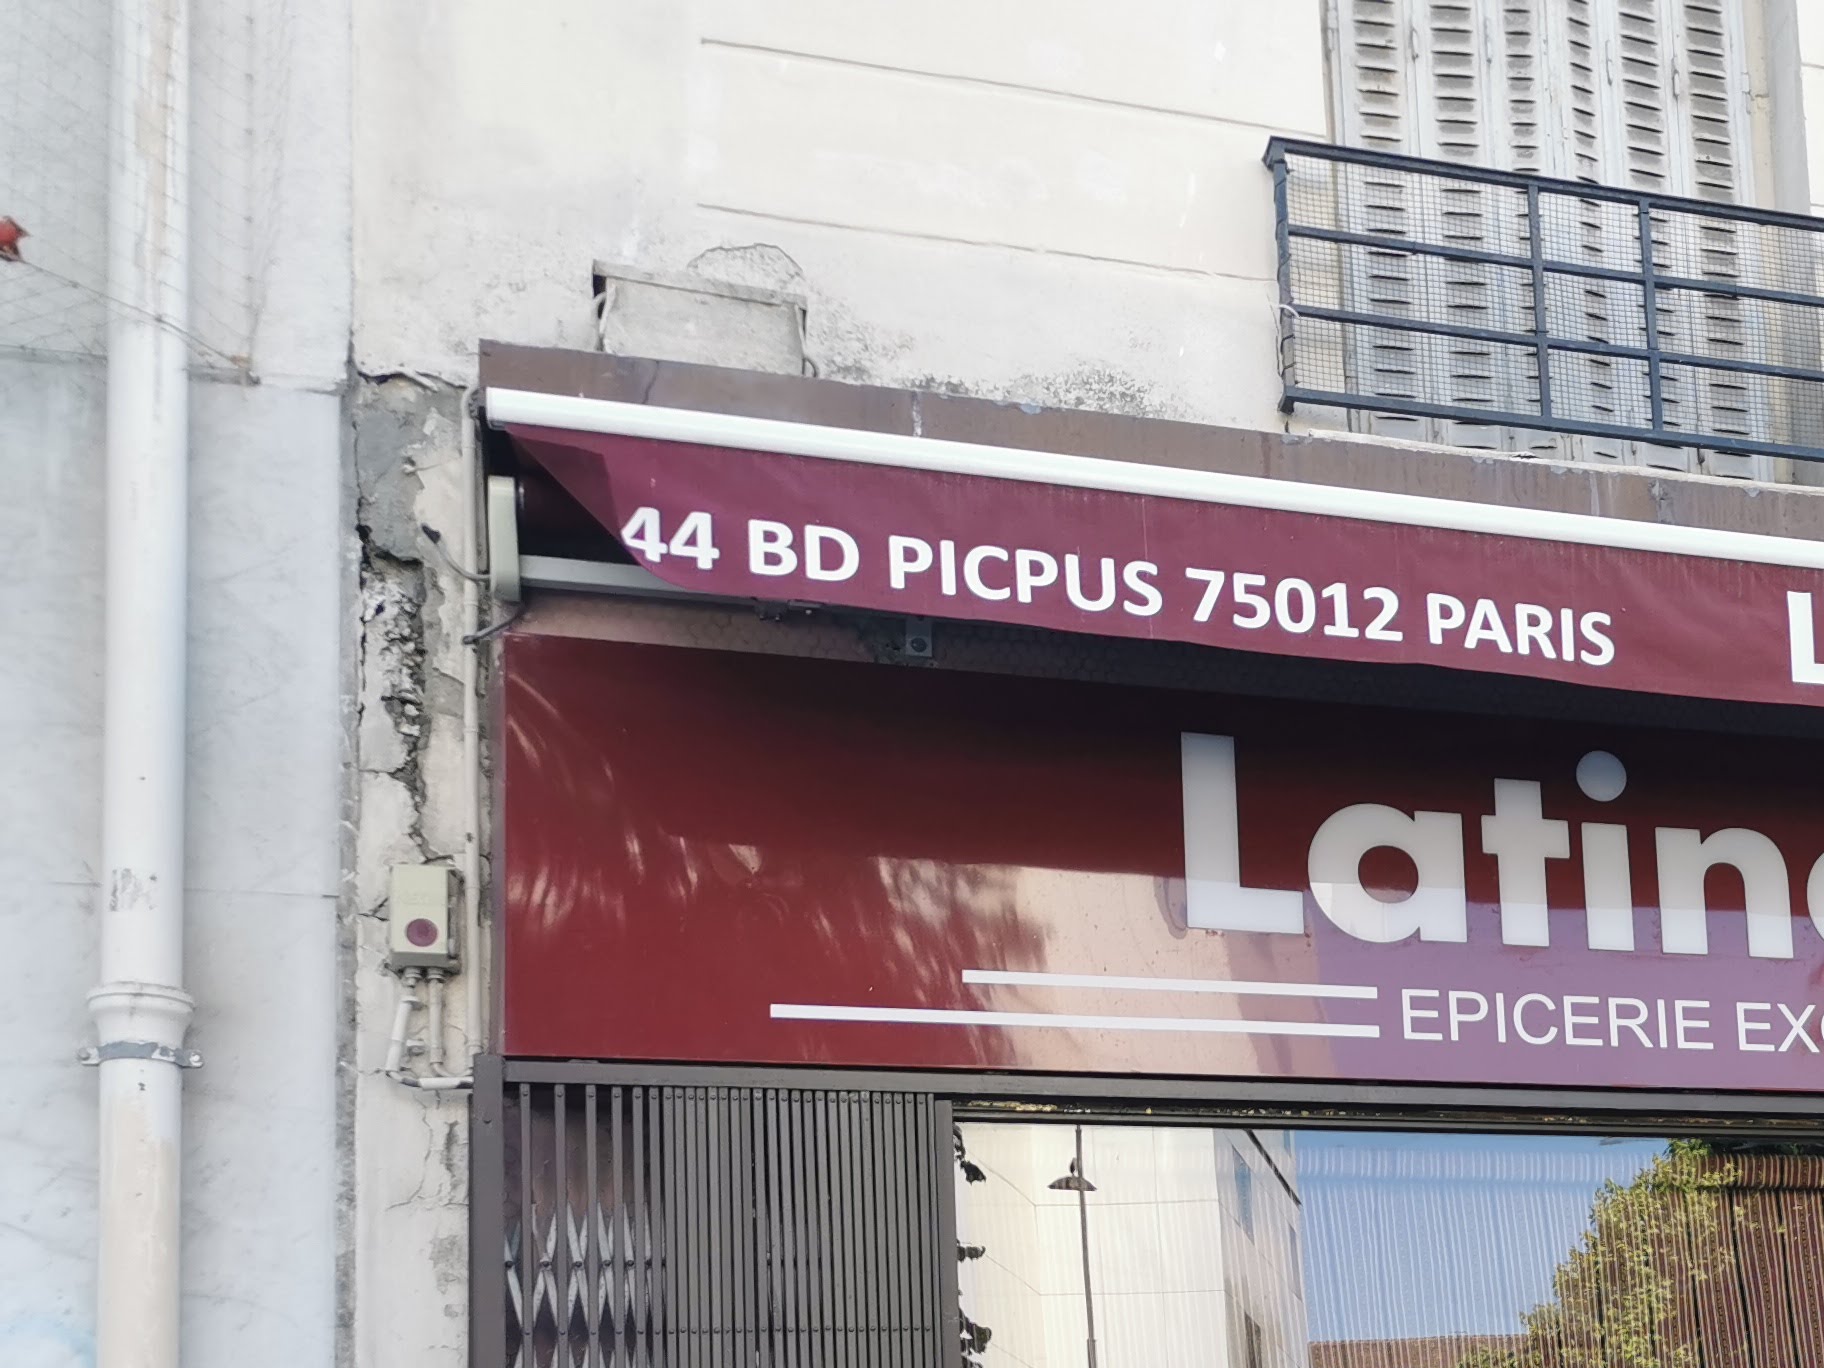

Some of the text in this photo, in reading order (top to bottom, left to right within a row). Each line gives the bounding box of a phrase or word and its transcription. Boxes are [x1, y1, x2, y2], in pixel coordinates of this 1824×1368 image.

[621, 506, 1615, 667] 44 BD PICPUS 75012 PARIS
[1401, 988, 1710, 1051] EPICERIE
